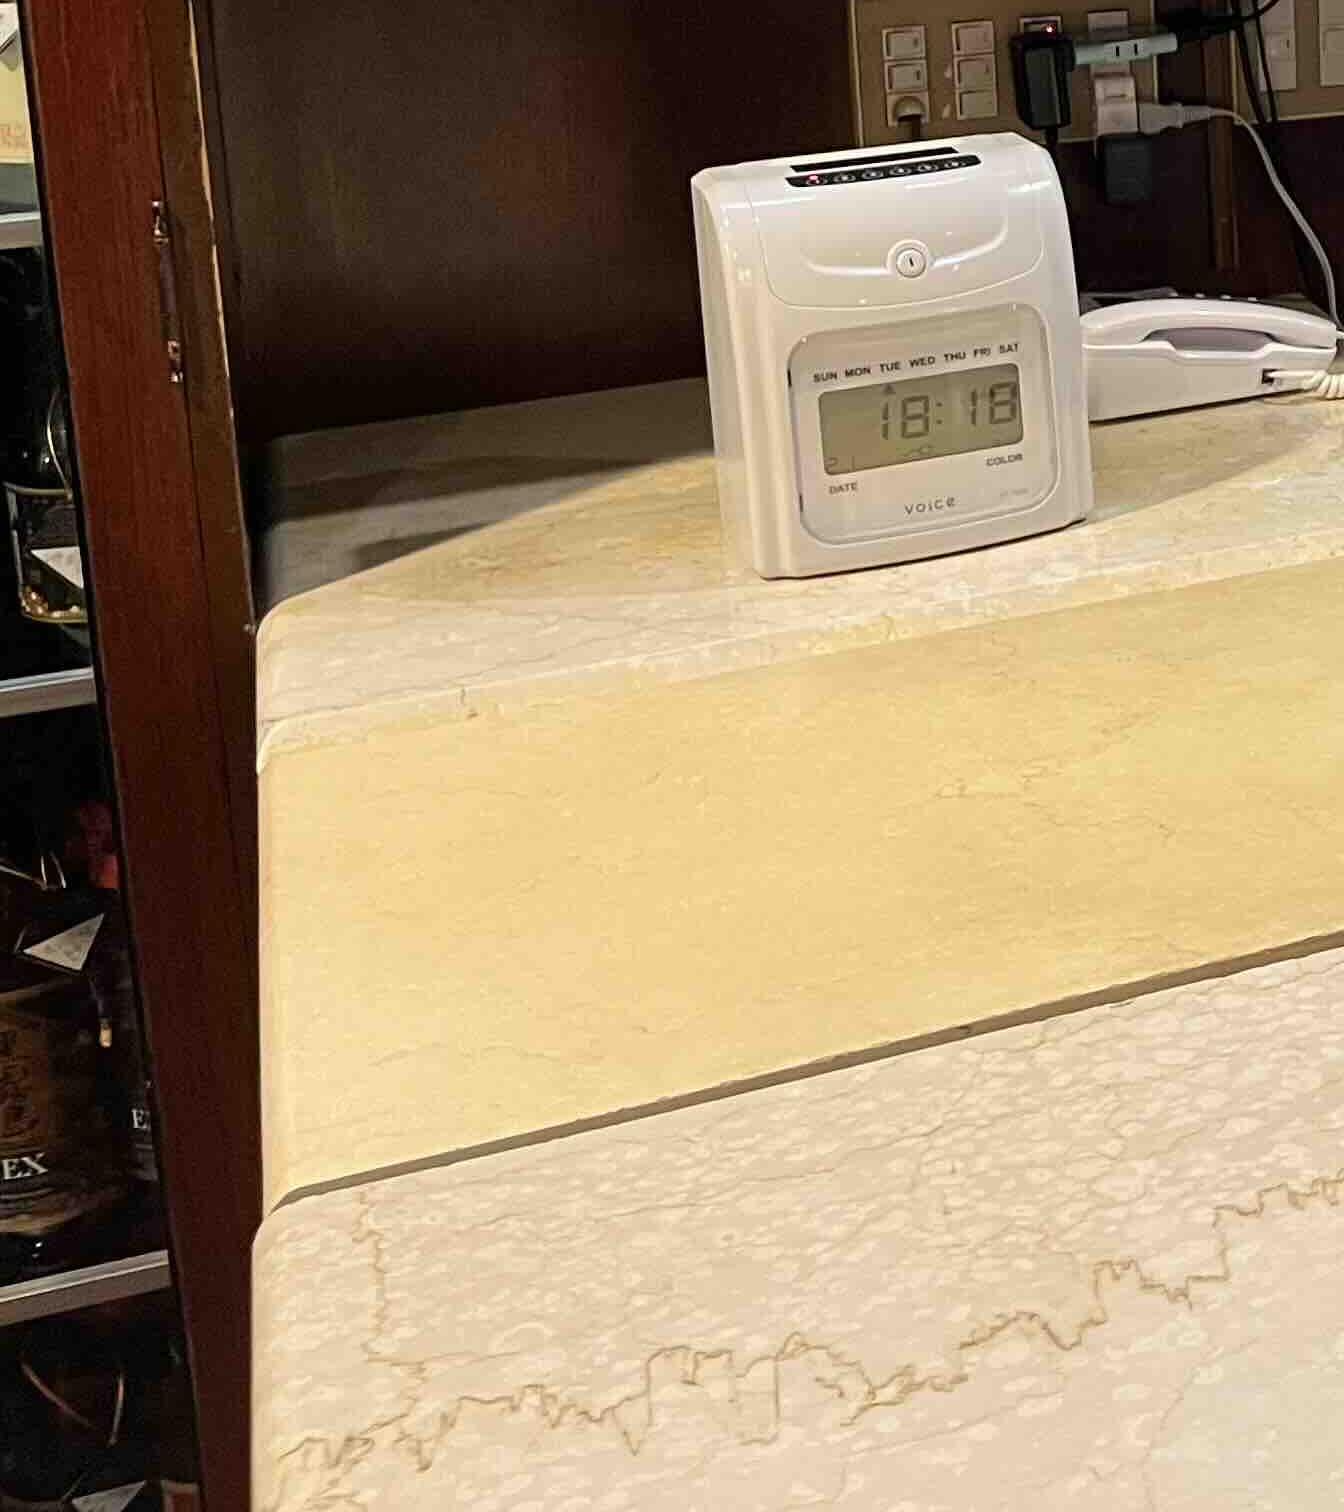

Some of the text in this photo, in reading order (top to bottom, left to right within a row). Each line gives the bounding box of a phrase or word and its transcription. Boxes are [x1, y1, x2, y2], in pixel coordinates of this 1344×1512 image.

[813, 343, 1019, 384] SUN MON TUE WED THU FRI SAT
[882, 381, 1018, 441] 18:18
[828, 482, 858, 495] DATE
